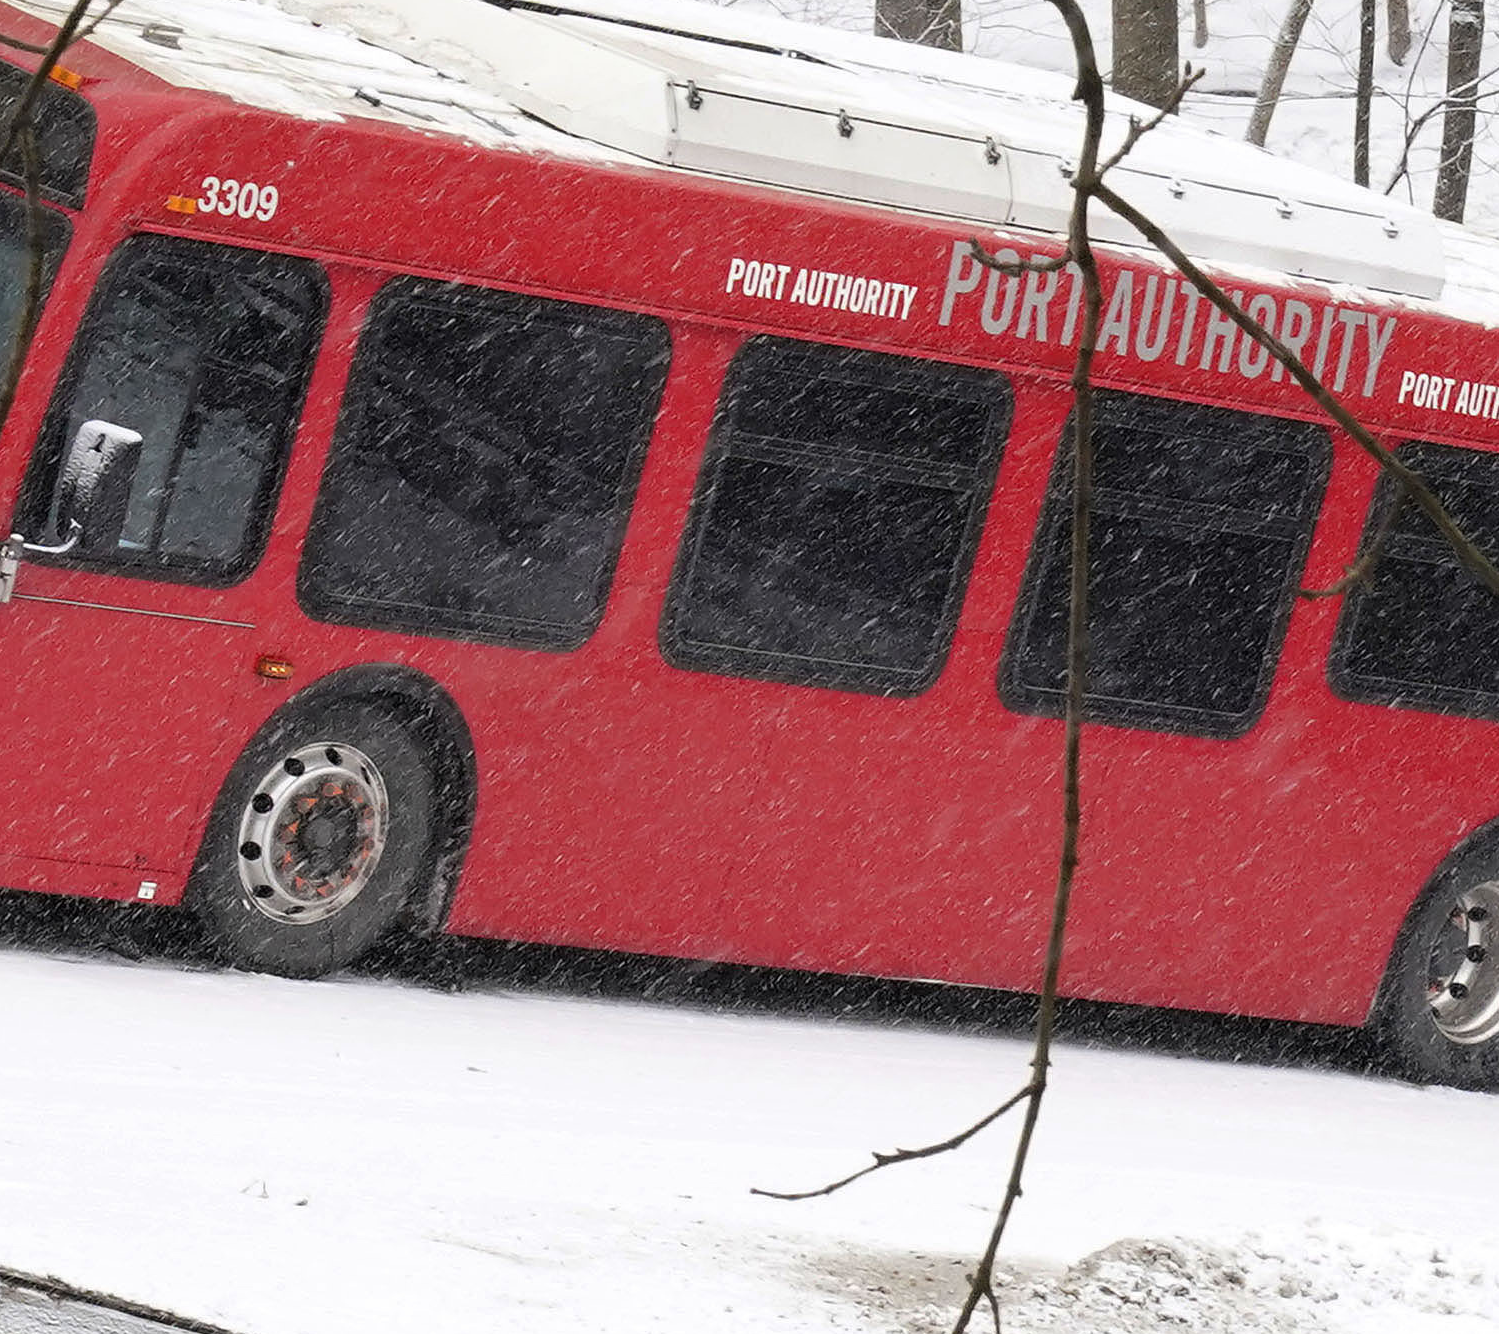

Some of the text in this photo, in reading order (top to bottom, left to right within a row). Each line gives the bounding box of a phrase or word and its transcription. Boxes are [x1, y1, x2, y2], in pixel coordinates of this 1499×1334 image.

[197, 175, 279, 222] 3309
[725, 258, 918, 321] PORT AUTHORITY
[938, 240, 1398, 398] PORT AUTHORITY
[1397, 370, 1456, 411] PORT
